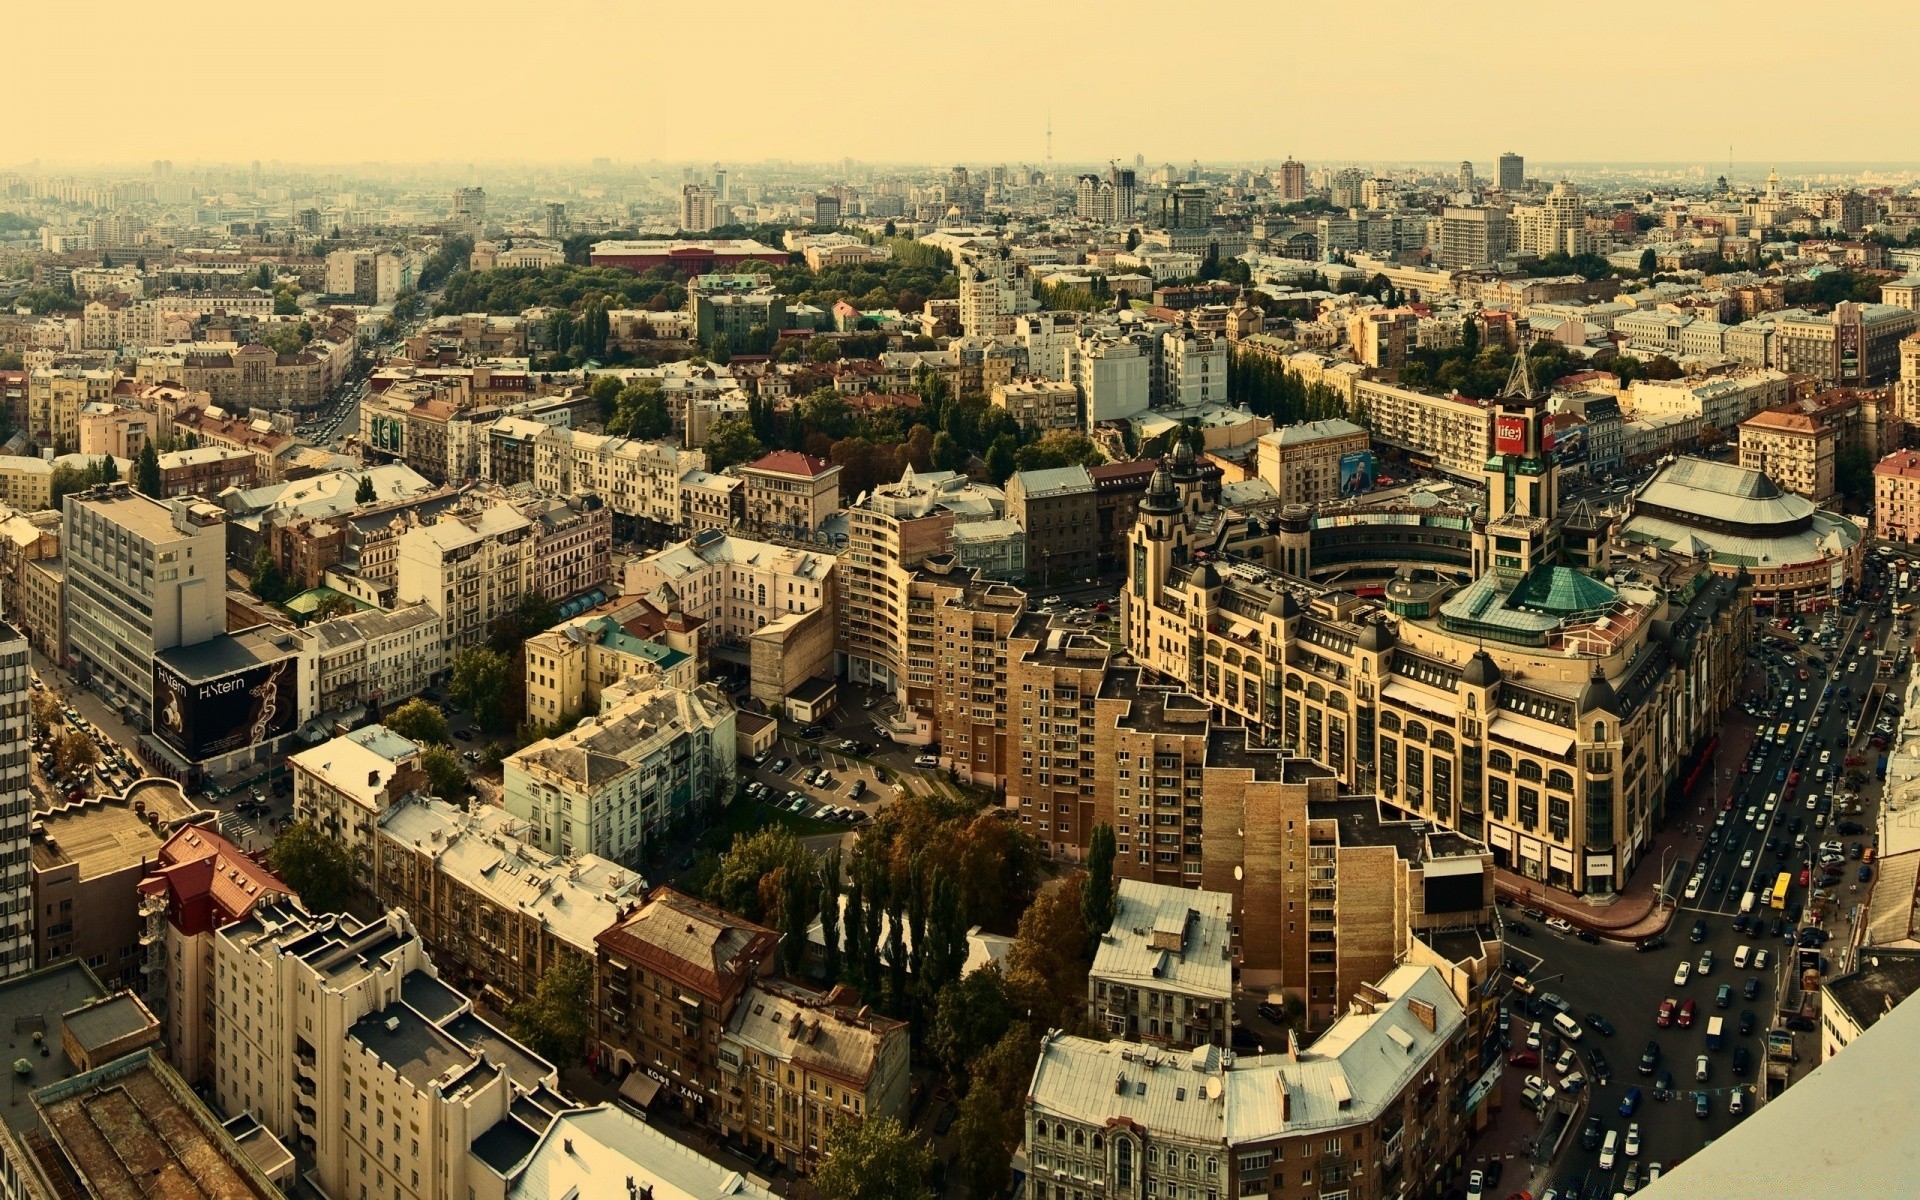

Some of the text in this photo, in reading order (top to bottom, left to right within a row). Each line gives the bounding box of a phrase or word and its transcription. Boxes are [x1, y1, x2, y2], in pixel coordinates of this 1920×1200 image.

[1498, 425, 1522, 441] life:)
[647, 1068, 703, 1104] КОФЕ ХАУЗ
